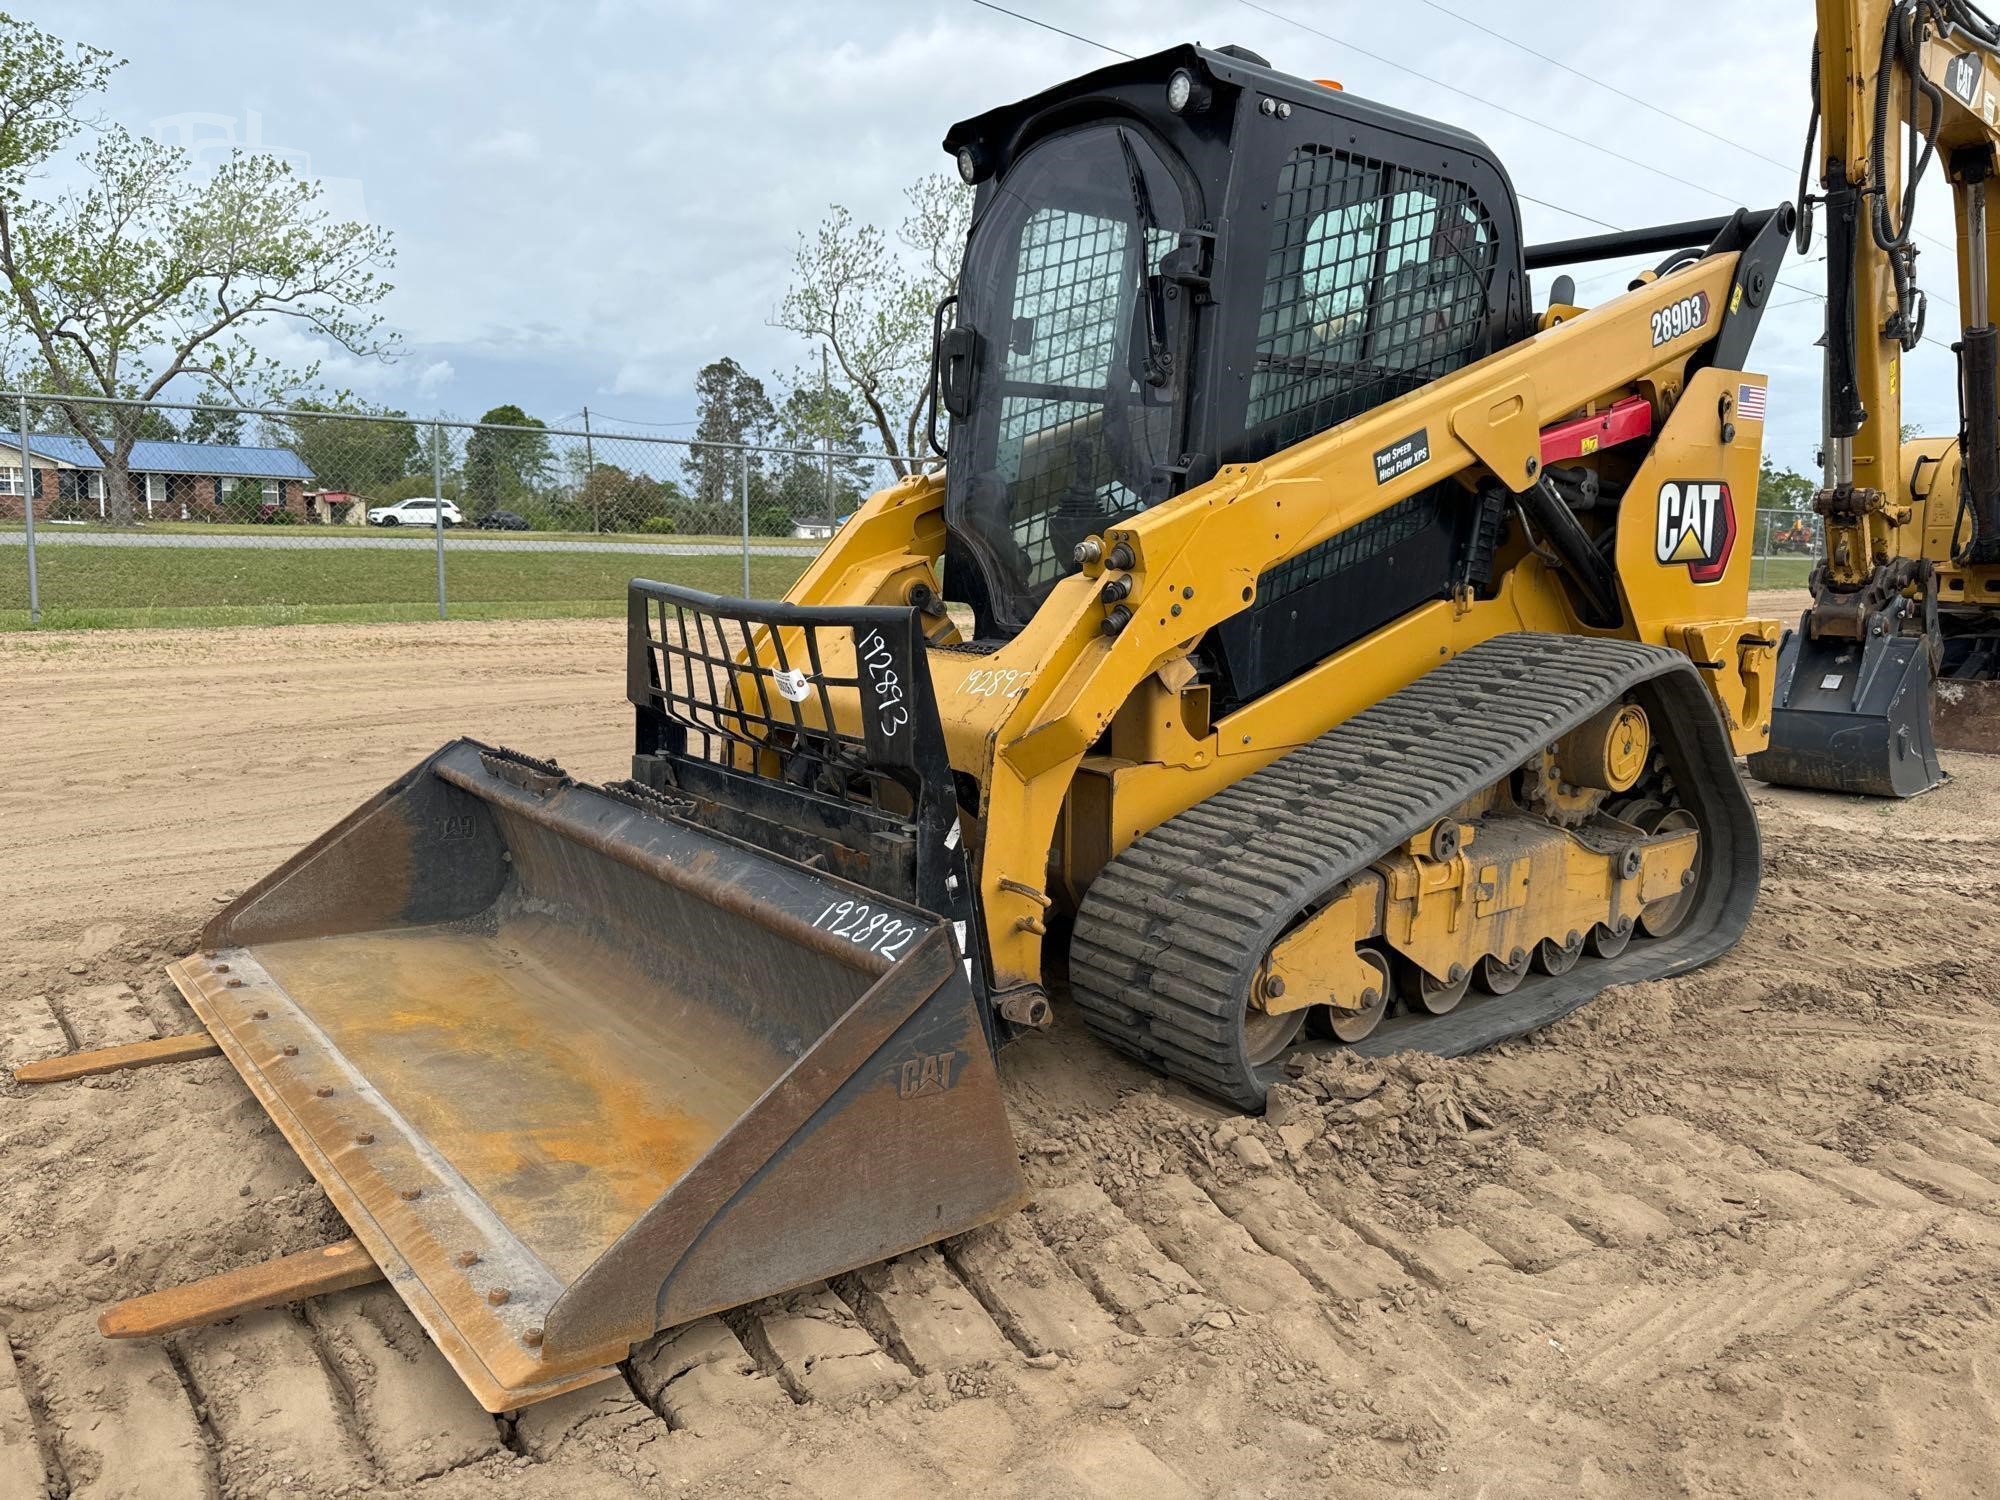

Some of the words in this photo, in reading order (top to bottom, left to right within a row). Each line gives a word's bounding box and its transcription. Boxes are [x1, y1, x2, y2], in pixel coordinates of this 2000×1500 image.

[1956, 58, 1973, 101] CAT
[1651, 295, 1701, 347] 289D3
[1413, 447, 1427, 463] XPS
[1656, 482, 1721, 562] CAT
[859, 628, 908, 736] 192893
[811, 900, 914, 962] 192892
[900, 1051, 956, 1100] CAT
